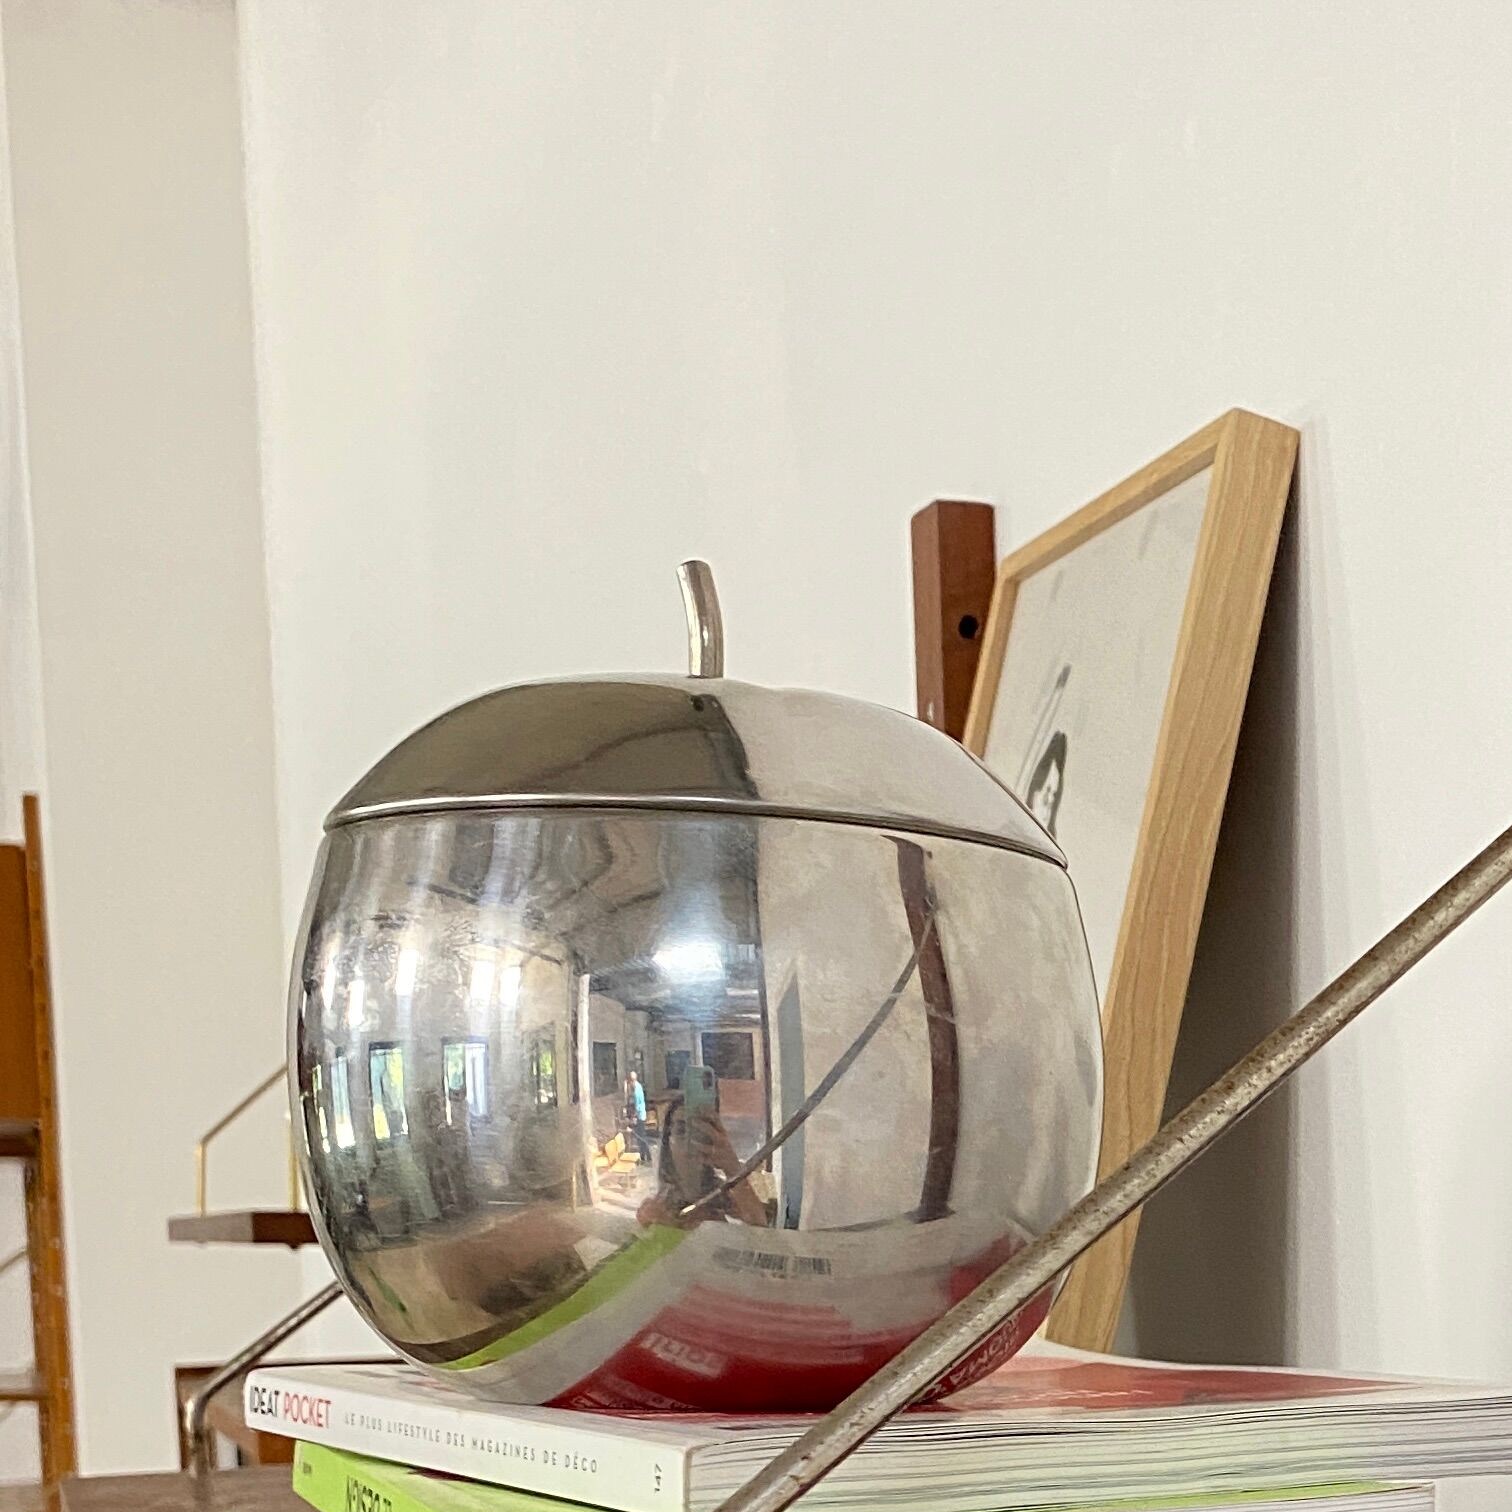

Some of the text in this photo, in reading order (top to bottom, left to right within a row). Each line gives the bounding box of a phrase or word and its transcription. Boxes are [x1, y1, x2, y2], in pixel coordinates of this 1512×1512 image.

[249, 1385, 332, 1429] IDEAT POCKET
[344, 1412, 598, 1474] LE PLUS LIFESTYLE DES MAGAZINES DE DÉCO
